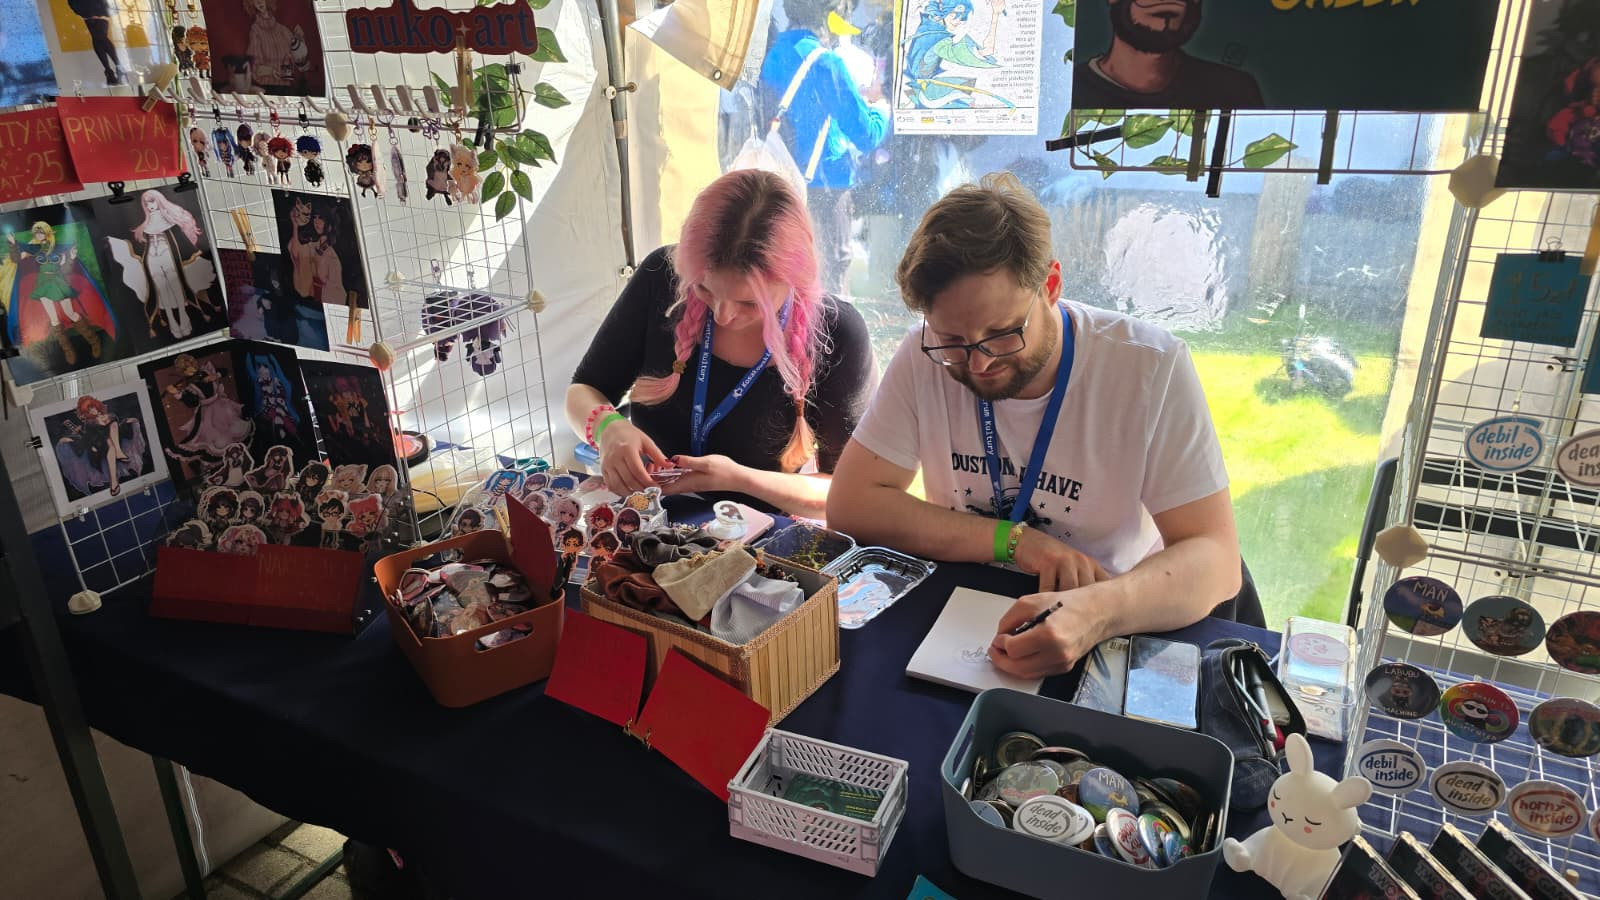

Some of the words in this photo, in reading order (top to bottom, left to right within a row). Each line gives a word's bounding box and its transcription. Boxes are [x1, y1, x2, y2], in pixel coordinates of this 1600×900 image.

[352, 0, 454, 48] nuko
[473, 8, 534, 49] art
[65, 113, 146, 145] PRINTY
[985, 420, 995, 456] Kultury
[1476, 425, 1520, 445] debil
[1483, 443, 1534, 461] inside
[1035, 471, 1083, 502] HAVE
[1413, 582, 1449, 602] MAN
[1365, 755, 1398, 770] debil
[1098, 772, 1126, 790] MAN
[1375, 768, 1414, 782] inside
[1445, 775, 1486, 793] dead
[1447, 789, 1491, 806] inside
[1518, 800, 1566, 812] horny
[1029, 804, 1061, 820] dead
[1529, 811, 1574, 826] inside
[1025, 815, 1062, 834] inside
